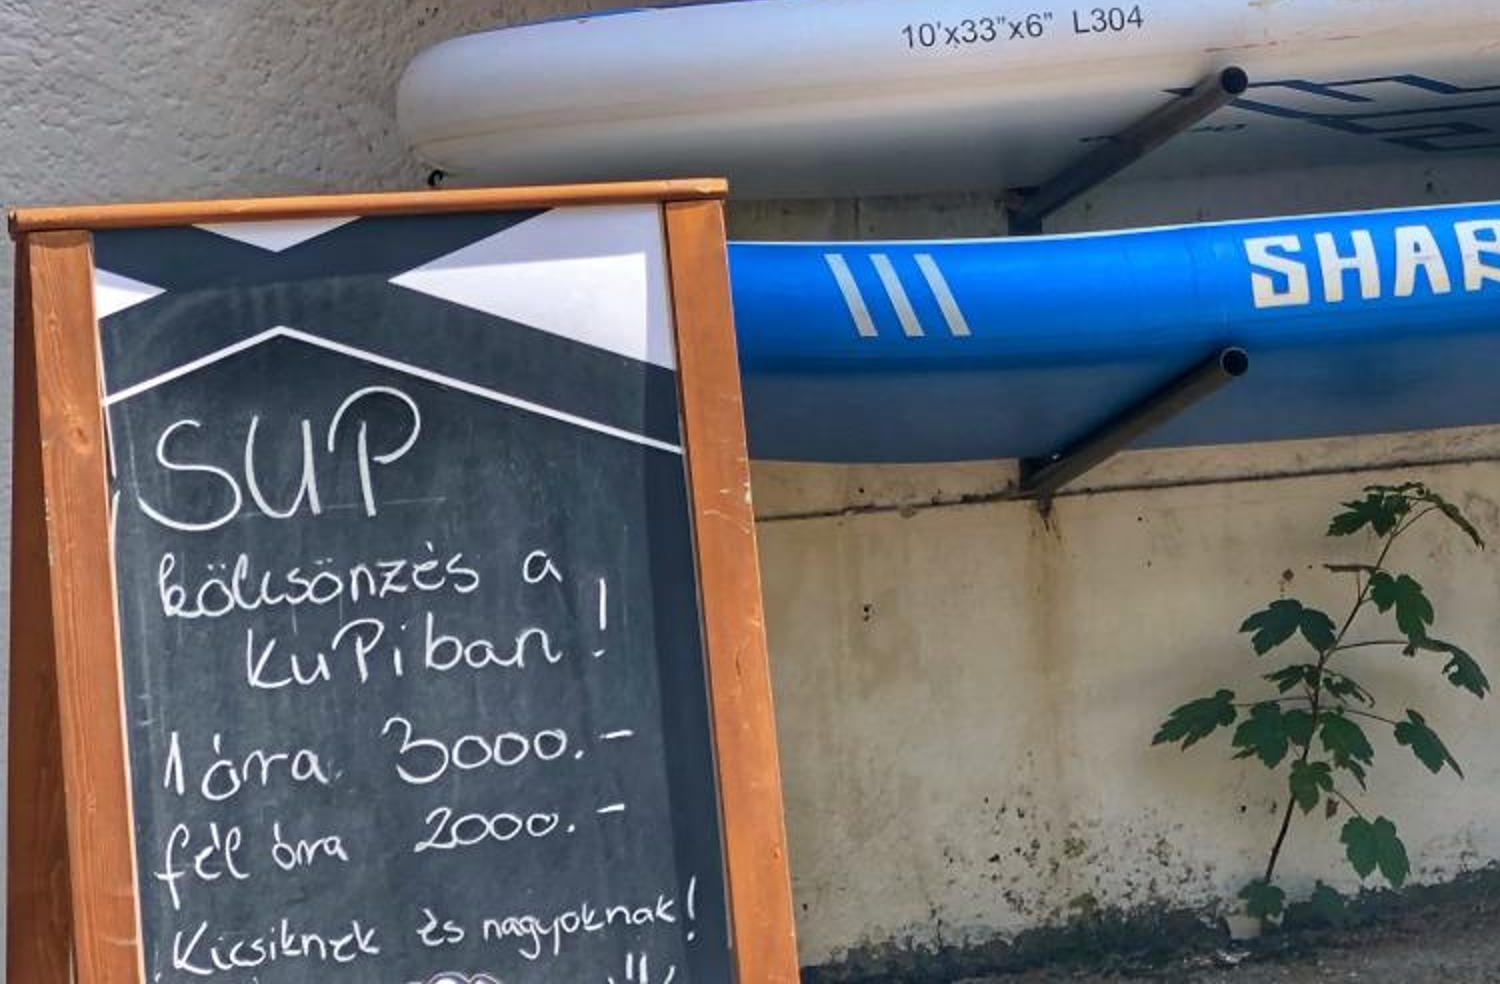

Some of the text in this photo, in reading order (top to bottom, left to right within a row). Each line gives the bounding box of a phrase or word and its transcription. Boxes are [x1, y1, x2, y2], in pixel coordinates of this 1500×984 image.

[1072, 4, 1145, 34] L304
[137, 386, 422, 531] SUP
[522, 549, 564, 584] a
